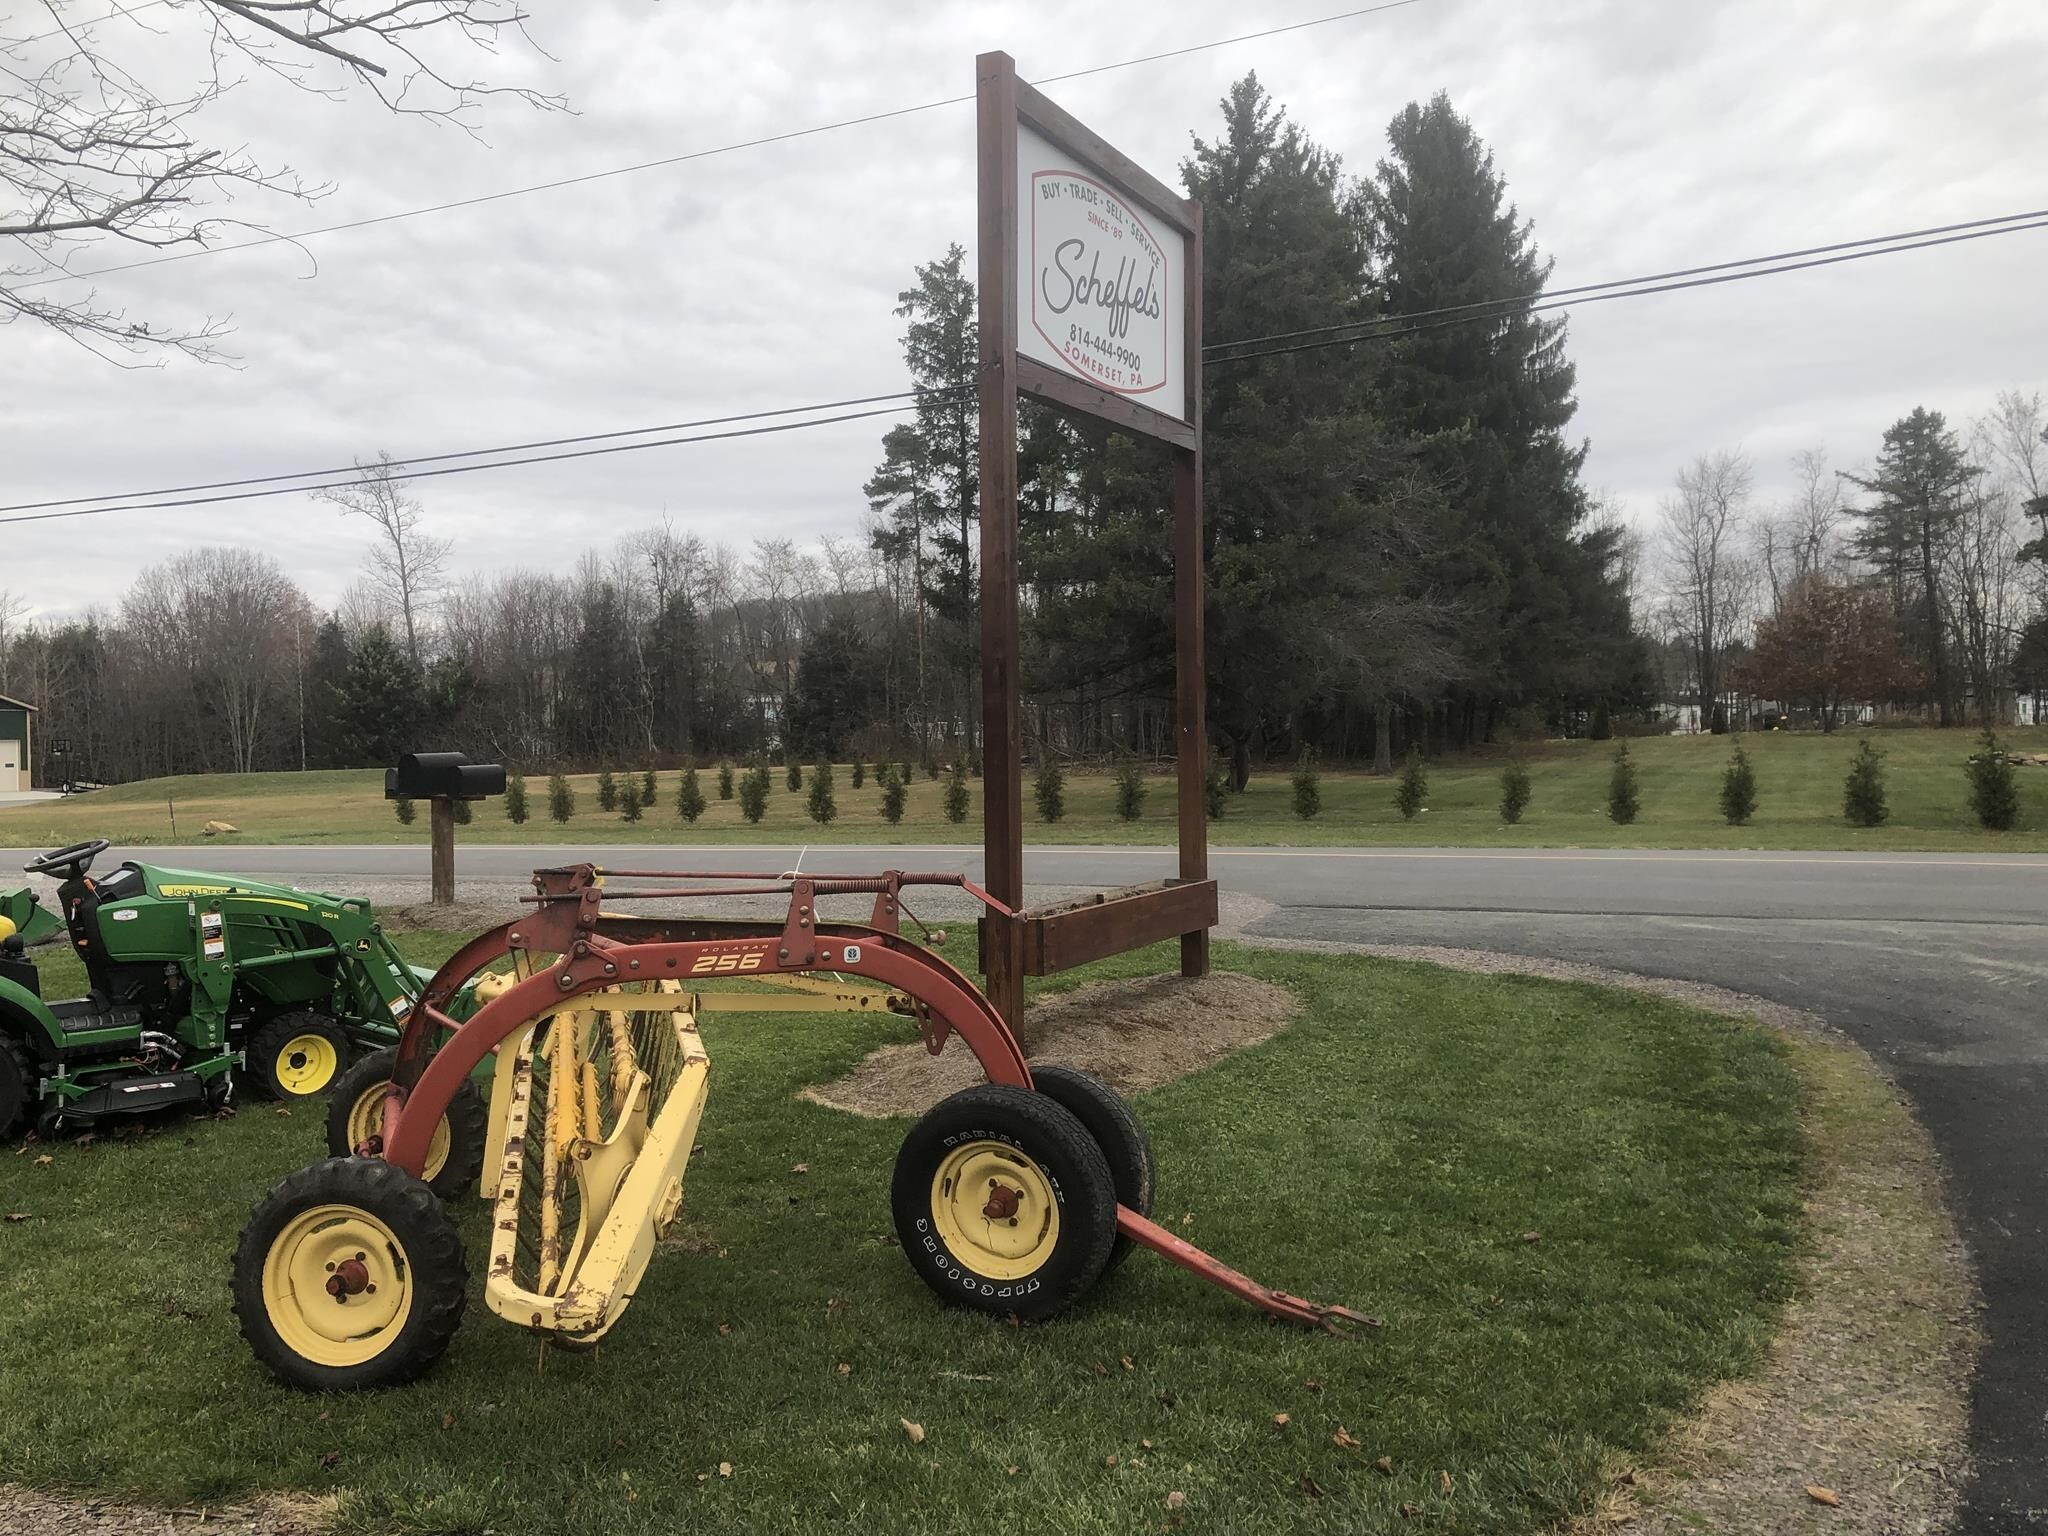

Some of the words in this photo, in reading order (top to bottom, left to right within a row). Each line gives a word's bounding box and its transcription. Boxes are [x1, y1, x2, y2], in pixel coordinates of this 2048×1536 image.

[1041, 182, 1061, 201] BUY
[1069, 183, 1098, 207] TRADE
[1106, 199, 1123, 225] SELL
[1130, 222, 1161, 270] SERVICE
[1087, 210, 1109, 233] SINCE
[1069, 323, 1142, 372] 814-444-9900
[1064, 340, 1126, 385] SOMERSET,
[1130, 370, 1143, 386] PA
[169, 887, 199, 897] JOHN
[701, 944, 769, 953] ROLABAR
[690, 952, 765, 973] 256
[943, 1129, 1024, 1151] RADIAL
